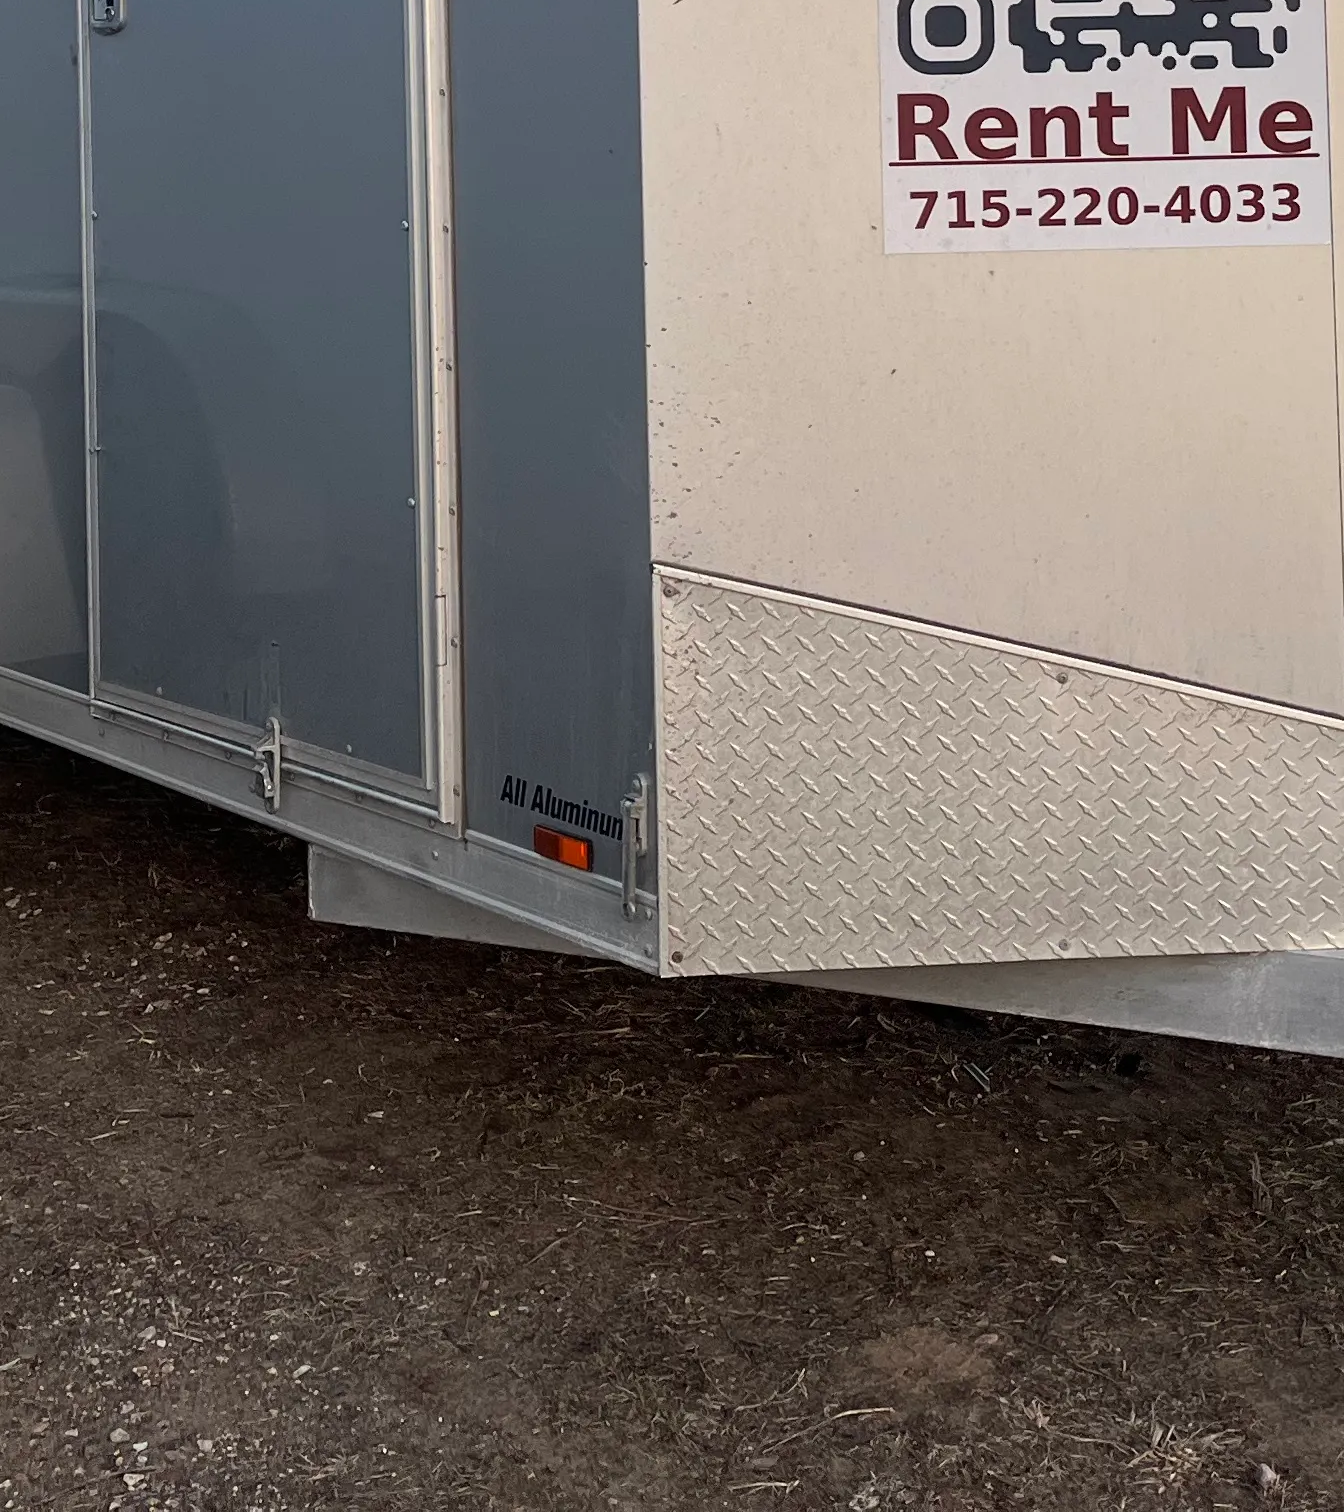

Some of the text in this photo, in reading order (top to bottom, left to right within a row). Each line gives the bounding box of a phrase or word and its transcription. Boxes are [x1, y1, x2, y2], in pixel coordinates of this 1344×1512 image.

[896, 86, 1314, 160] Rent Me
[909, 183, 1301, 230] 715-220-4033
[500, 774, 527, 808] All
